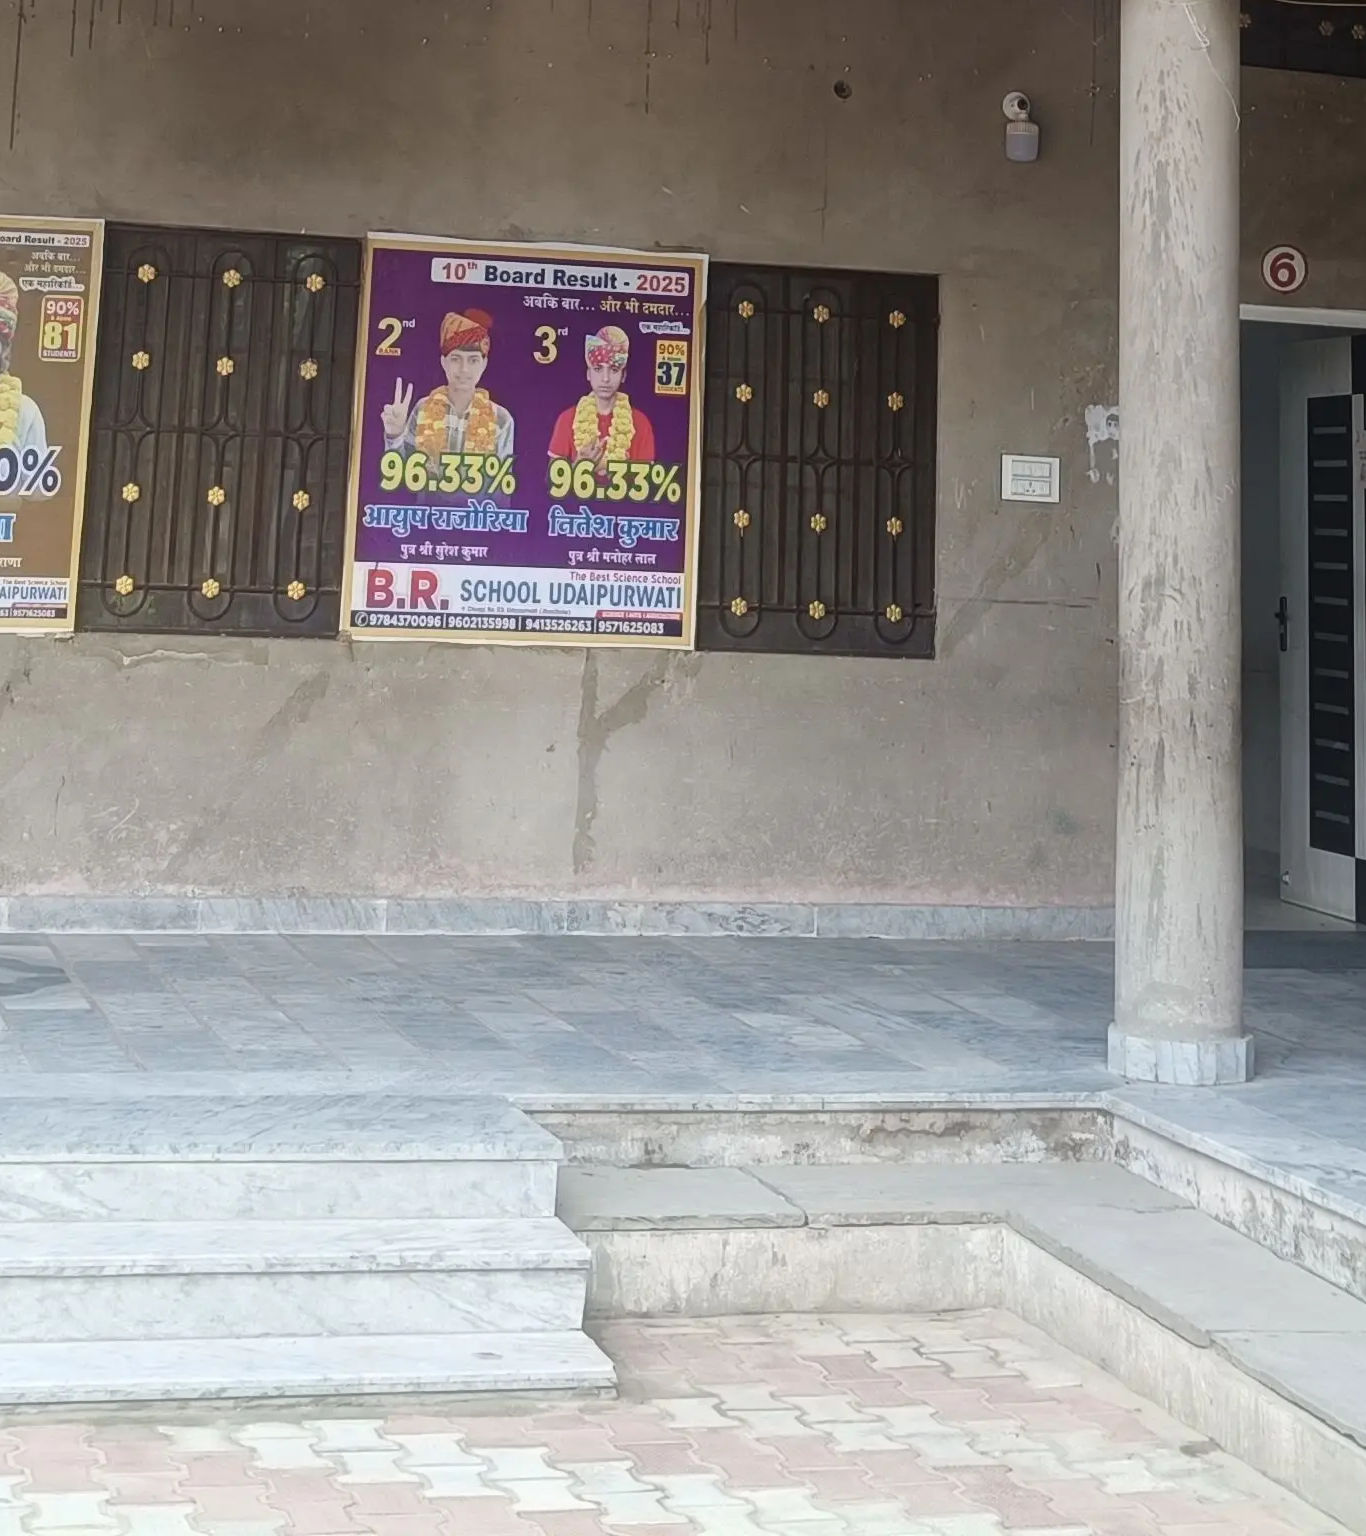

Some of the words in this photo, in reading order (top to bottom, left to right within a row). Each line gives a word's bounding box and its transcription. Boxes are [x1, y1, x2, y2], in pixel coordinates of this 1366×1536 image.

[442, 261, 477, 281] 10th
[484, 265, 545, 285] Board
[553, 268, 617, 290] Result
[636, 274, 685, 293] 2025
[1269, 252, 1296, 288] 6
[624, 299, 639, 313] भी
[377, 317, 416, 350] 2nd
[534, 325, 569, 363] 3rd
[380, 451, 516, 495] 96.33%
[549, 459, 681, 503] 96.33%
[363, 504, 430, 537] आयुष
[431, 500, 529, 533] राजोरिया
[548, 505, 614, 540] नितेश
[617, 515, 679, 547] कुमार
[419, 541, 433, 556] श्री
[461, 546, 487, 561] कुमार
[587, 548, 601, 563] श्री
[603, 550, 633, 564] मनोहर
[635, 553, 656, 565] लाल
[366, 569, 449, 610] B.R.
[460, 580, 541, 604] SCHOOL
[549, 582, 681, 608] UDAIPURWATI
[570, 572, 586, 582] The
[589, 572, 610, 582] Best
[613, 573, 648, 584] Science
[651, 575, 681, 585] School
[369, 614, 442, 627] 9784370096
[526, 618, 591, 632] 9413526263
[598, 621, 664, 634] 9571625083
